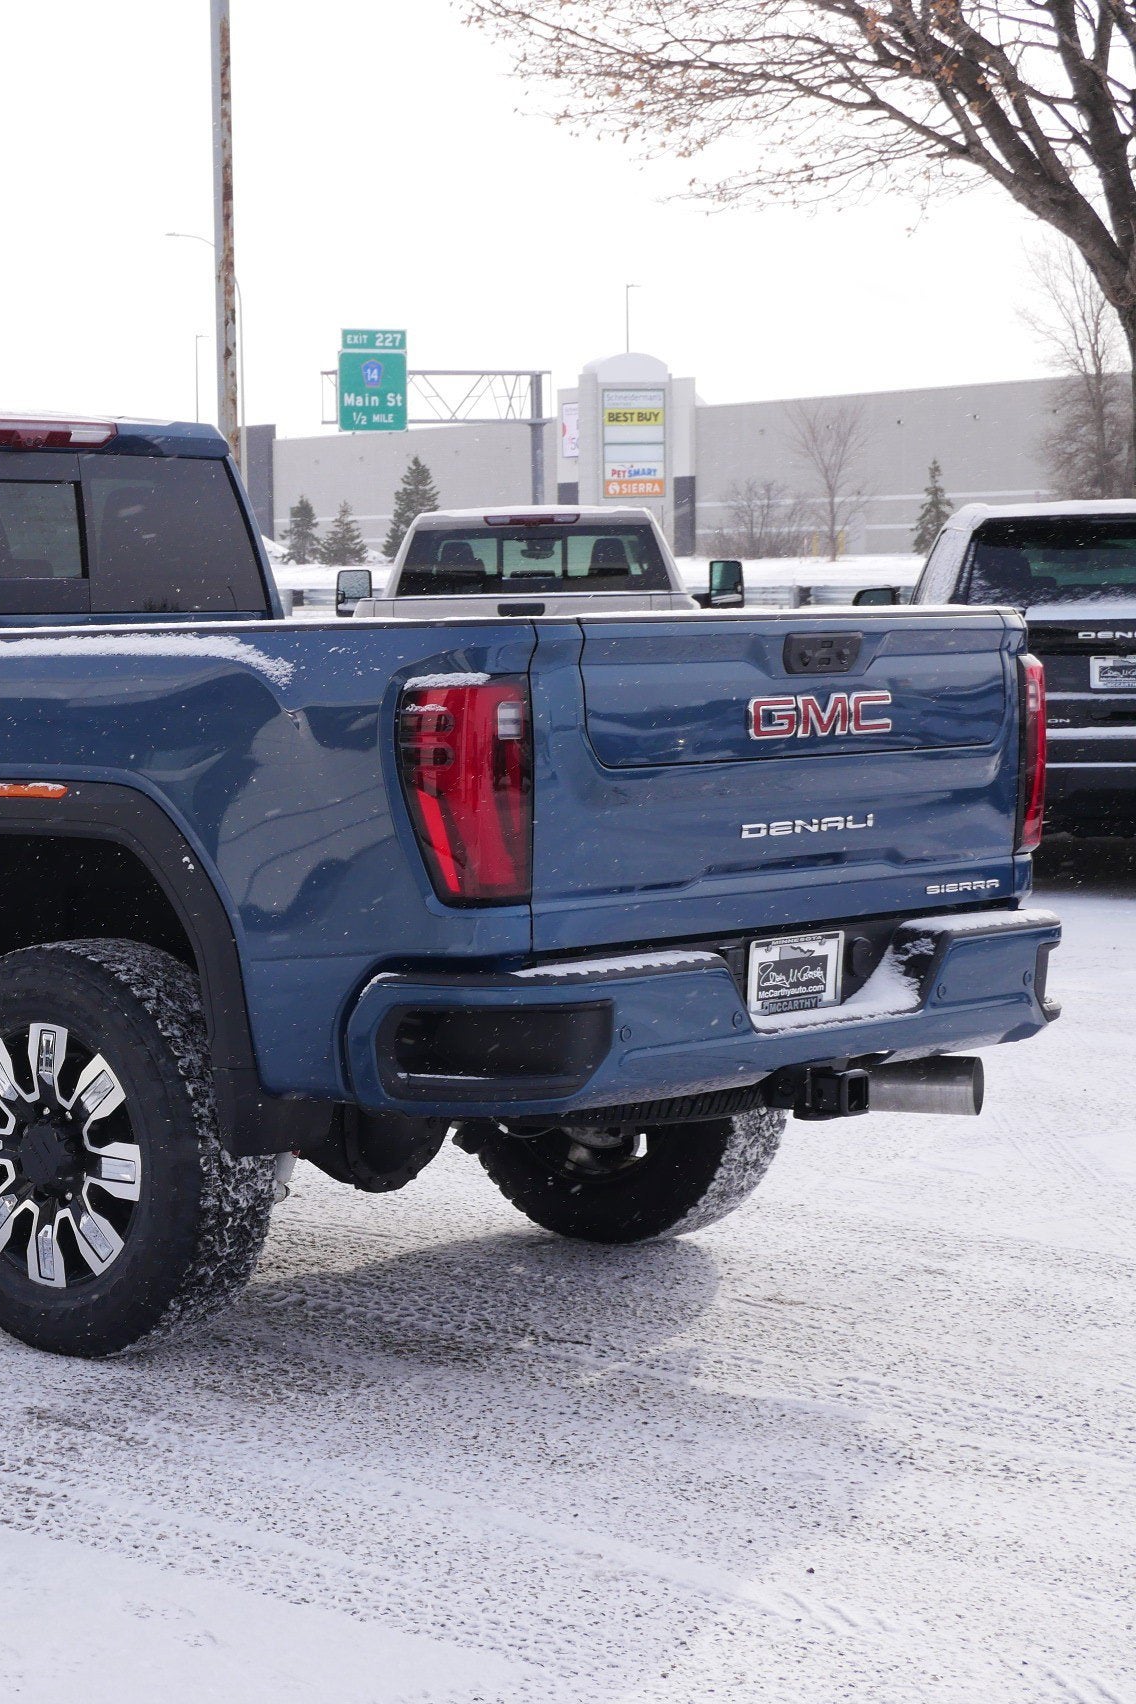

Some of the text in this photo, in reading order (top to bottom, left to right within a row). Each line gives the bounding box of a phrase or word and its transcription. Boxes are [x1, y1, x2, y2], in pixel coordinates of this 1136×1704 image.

[346, 333, 401, 346] EXIT 227
[367, 368, 378, 381] 14
[344, 393, 402, 407] Main St
[373, 414, 394, 423] MILE
[608, 411, 660, 422] BEST BUY
[622, 482, 660, 493] SIERRA
[1078, 631, 1136, 639] DEN
[749, 690, 892, 741] GMC
[741, 813, 874, 839] DENALI
[926, 879, 1000, 895] SIERRA
[772, 935, 823, 945] MINNESOTA
[758, 984, 824, 999] McCarthyauto.com
[769, 997, 817, 1013] MCCARTHY
